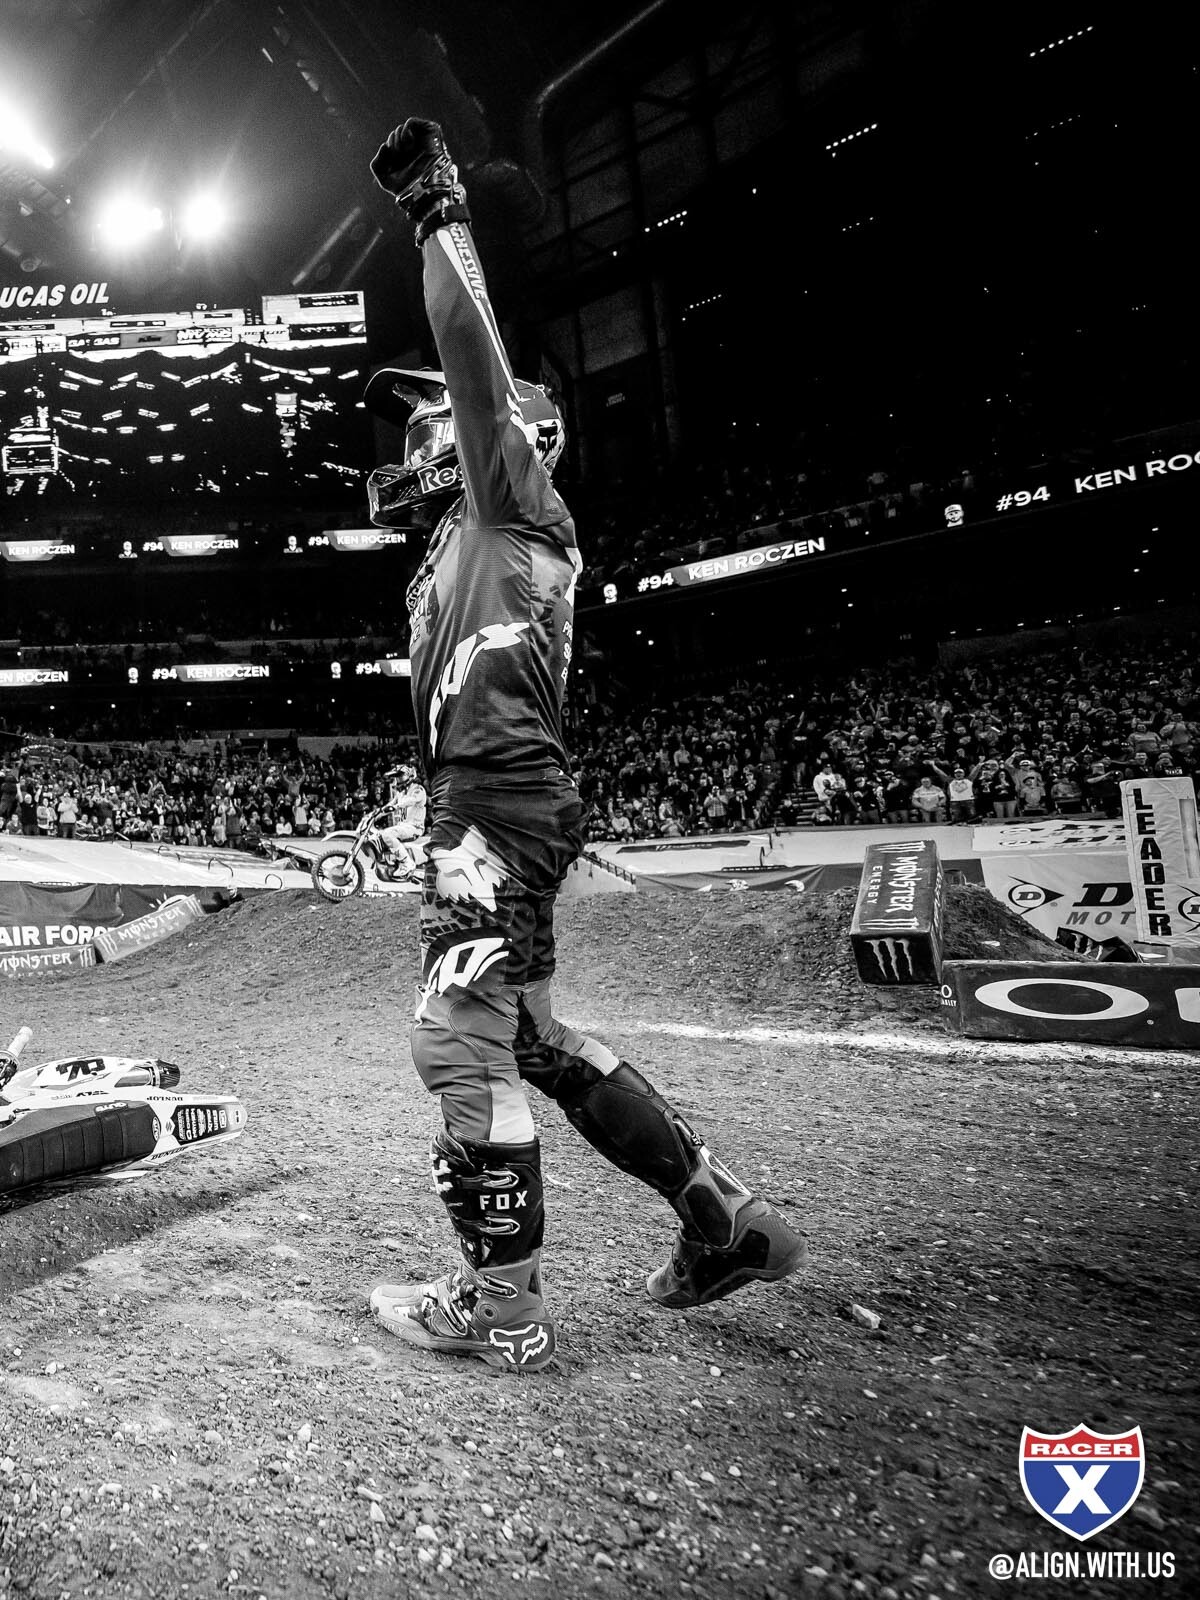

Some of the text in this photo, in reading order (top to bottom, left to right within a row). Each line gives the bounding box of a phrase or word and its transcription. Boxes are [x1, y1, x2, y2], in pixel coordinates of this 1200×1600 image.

[70, 283, 110, 305] OIL
[995, 450, 1200, 511] #94 KEN RO
[142, 539, 239, 551] #94 KEN ROCZEN
[308, 533, 406, 546] #94 KEN ROCZEN
[8, 546, 30, 556] KEN
[31, 544, 76, 555] ROCZEN
[636, 537, 826, 592] #94 KEN ROCZEN
[15, 670, 69, 683] ROCZEN
[152, 665, 270, 680] #94 KEN ROCZEN
[355, 662, 382, 675] #94
[1132, 788, 1173, 937] LEADER
[866, 865, 883, 904] ENERGY
[885, 856, 923, 914] MONSTER
[1065, 909, 1136, 925] MOT
[49, 925, 116, 945] FOR
[479, 1190, 528, 1210] FOX
